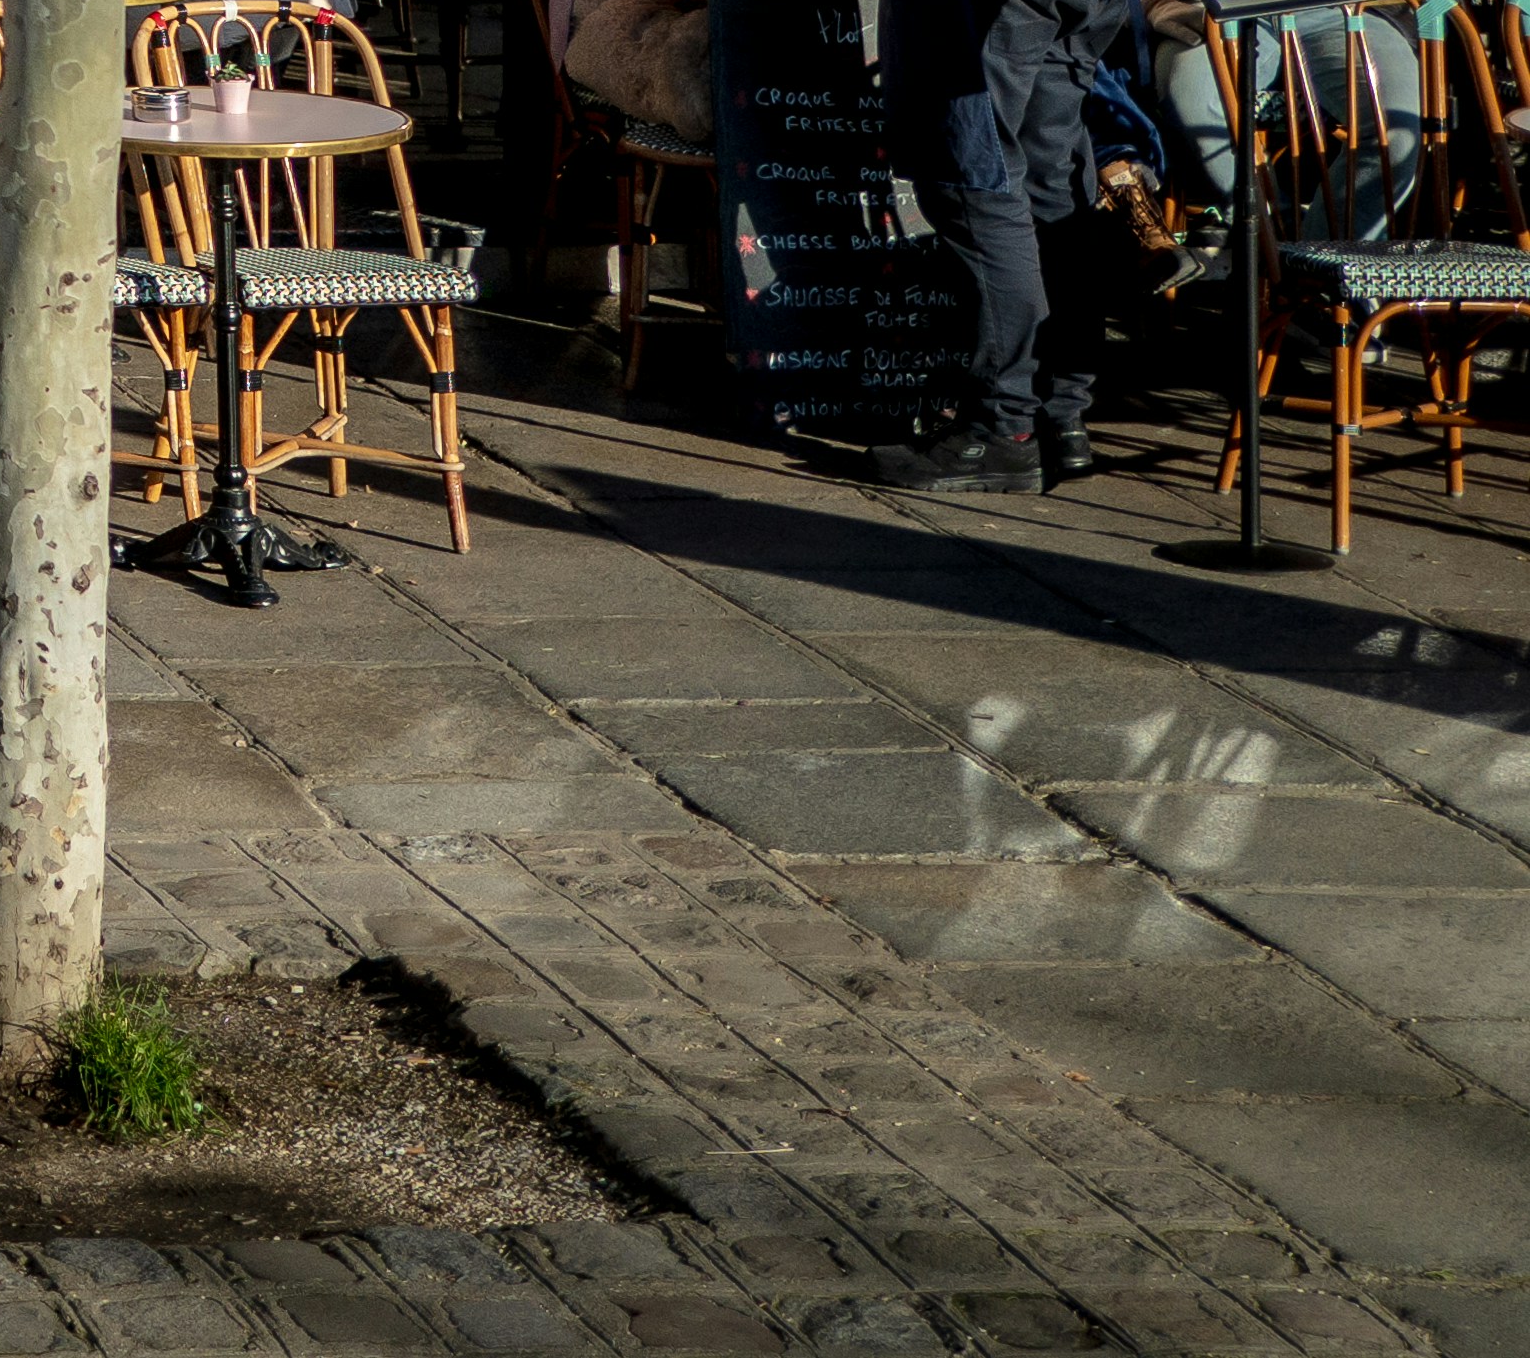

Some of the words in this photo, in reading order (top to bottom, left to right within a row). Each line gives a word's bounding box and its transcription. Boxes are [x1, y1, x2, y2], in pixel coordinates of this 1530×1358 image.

[755, 87, 835, 109] CROQUE
[785, 115, 856, 132] FRITES
[756, 163, 835, 181] CROQUE
[860, 168, 892, 182] POU
[756, 234, 837, 250] CHEESE
[765, 282, 860, 307] SAUCISSE
[767, 349, 852, 370] LASAGNE
